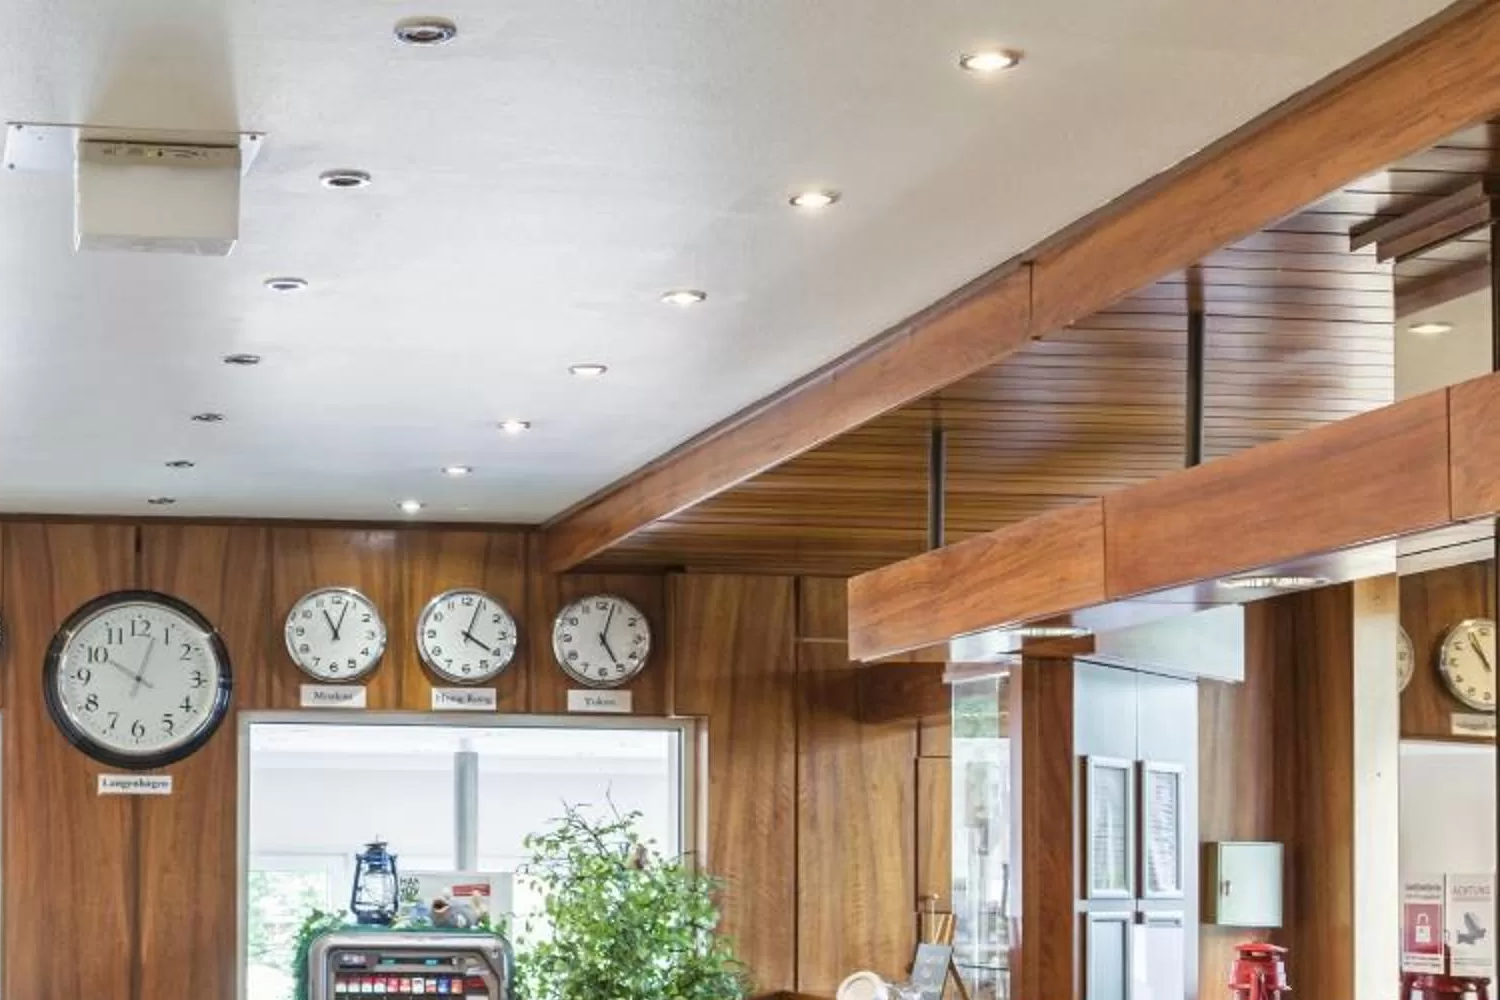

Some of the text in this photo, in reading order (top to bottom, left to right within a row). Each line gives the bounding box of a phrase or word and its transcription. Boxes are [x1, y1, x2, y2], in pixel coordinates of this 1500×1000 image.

[332, 597, 343, 605] 12
[462, 597, 473, 606] 12
[596, 602, 608, 611] 12
[362, 614, 372, 623] 2
[492, 614, 501, 624] 2
[628, 617, 638, 627] 2
[131, 620, 151, 638] 12
[296, 627, 305, 637] 9
[107, 628, 124, 645] 11
[165, 628, 170, 645] 1
[366, 631, 376, 640] 3
[428, 630, 437, 639] 9
[498, 632, 508, 641] 3
[564, 634, 573, 643] 9
[632, 635, 643, 645] 3
[180, 644, 192, 661] 2
[300, 644, 310, 654] 8
[361, 648, 369, 657] 4
[432, 646, 443, 657] 8
[492, 648, 501, 657] 4
[88, 647, 109, 664] 10
[568, 650, 579, 661] 8
[628, 652, 638, 660] 4
[312, 657, 321, 667] 7
[348, 659, 357, 669] 5
[444, 660, 453, 669] 7
[479, 660, 489, 669] 5
[330, 662, 339, 673] 6
[462, 664, 472, 674] 6
[581, 663, 589, 673] 7
[599, 668, 608, 677] 6
[616, 664, 626, 673] 5
[77, 668, 92, 686] 9
[191, 671, 202, 689] 3
[85, 694, 99, 713] 8
[180, 696, 193, 713] 4
[108, 712, 120, 730] 7
[162, 714, 174, 736] 5
[132, 720, 146, 738] 6
